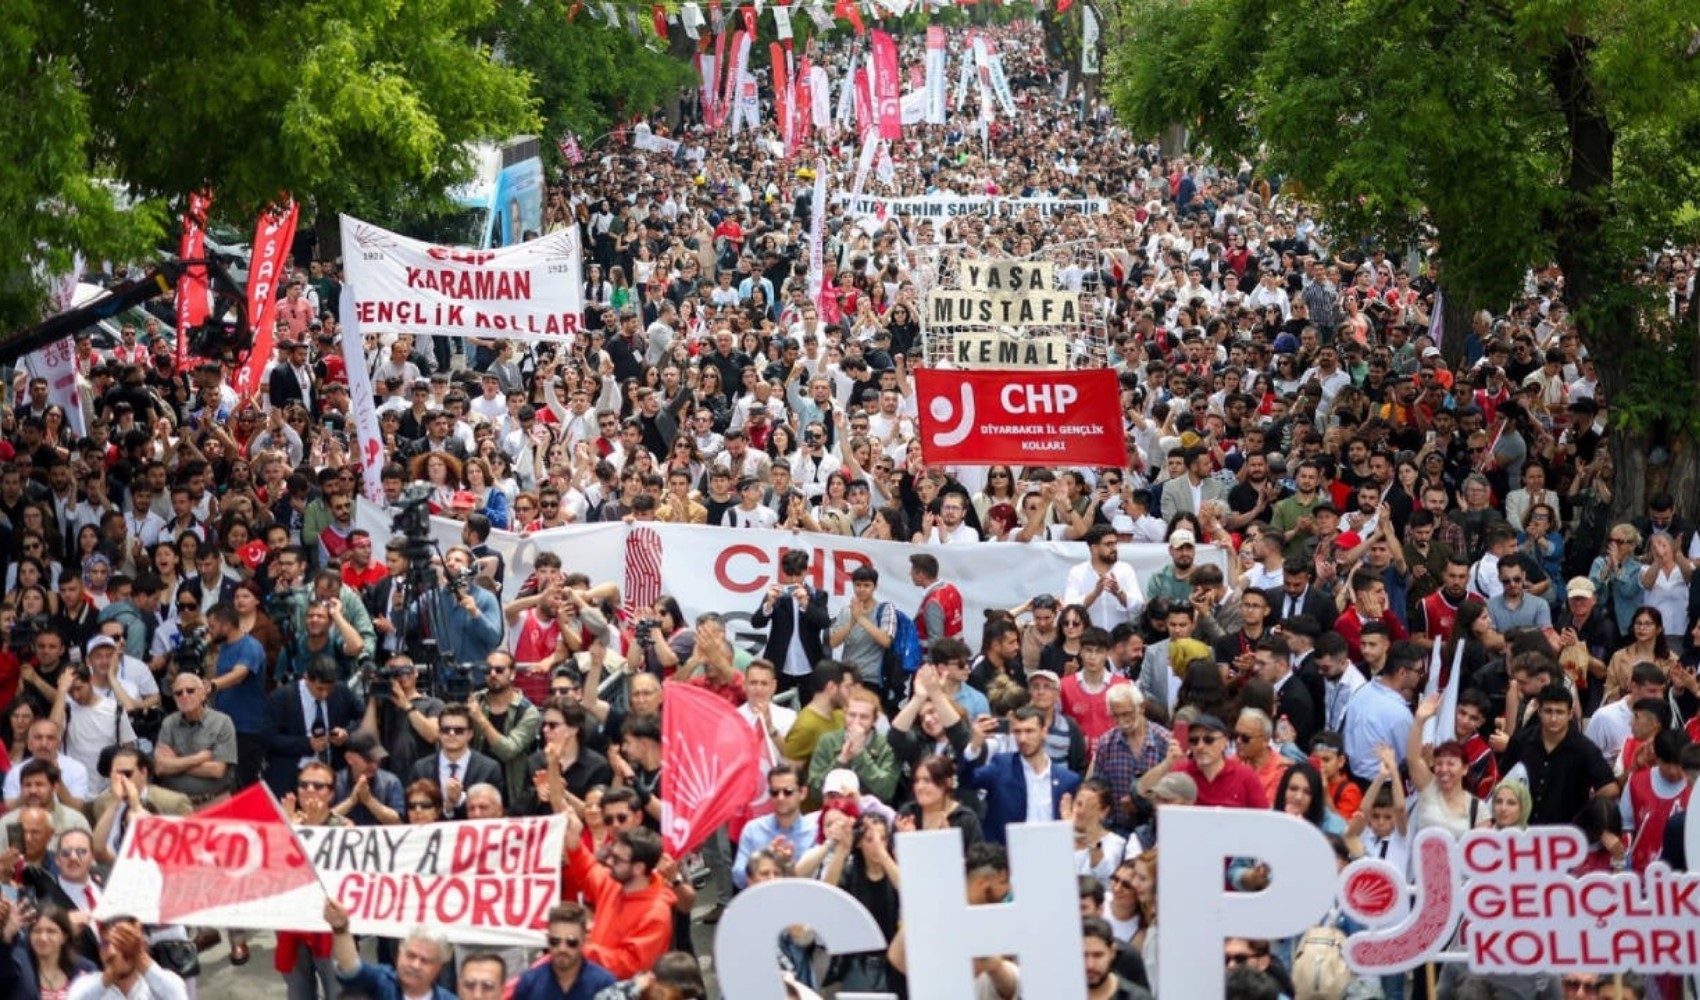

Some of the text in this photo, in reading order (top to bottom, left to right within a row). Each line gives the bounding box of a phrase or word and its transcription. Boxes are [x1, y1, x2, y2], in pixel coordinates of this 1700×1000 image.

[405, 266, 531, 300] KARAMAN
[969, 265, 1043, 291] YAŞA
[935, 297, 1076, 323] MUSTAFA
[958, 340, 1058, 365] KEMAL
[999, 383, 1079, 415] CHP
[980, 424, 1104, 436] DİYARBAKIR İL GENÇLİK
[1021, 441, 1066, 451] KOLLARI
[714, 543, 874, 597] CHP
[452, 817, 556, 874] DEĞİL
[1464, 836, 1579, 873] CHP
[340, 874, 557, 930] GİDİYORUZ
[1467, 871, 1700, 928] GENÇLİK
[1474, 929, 1698, 966] KOLLARI
